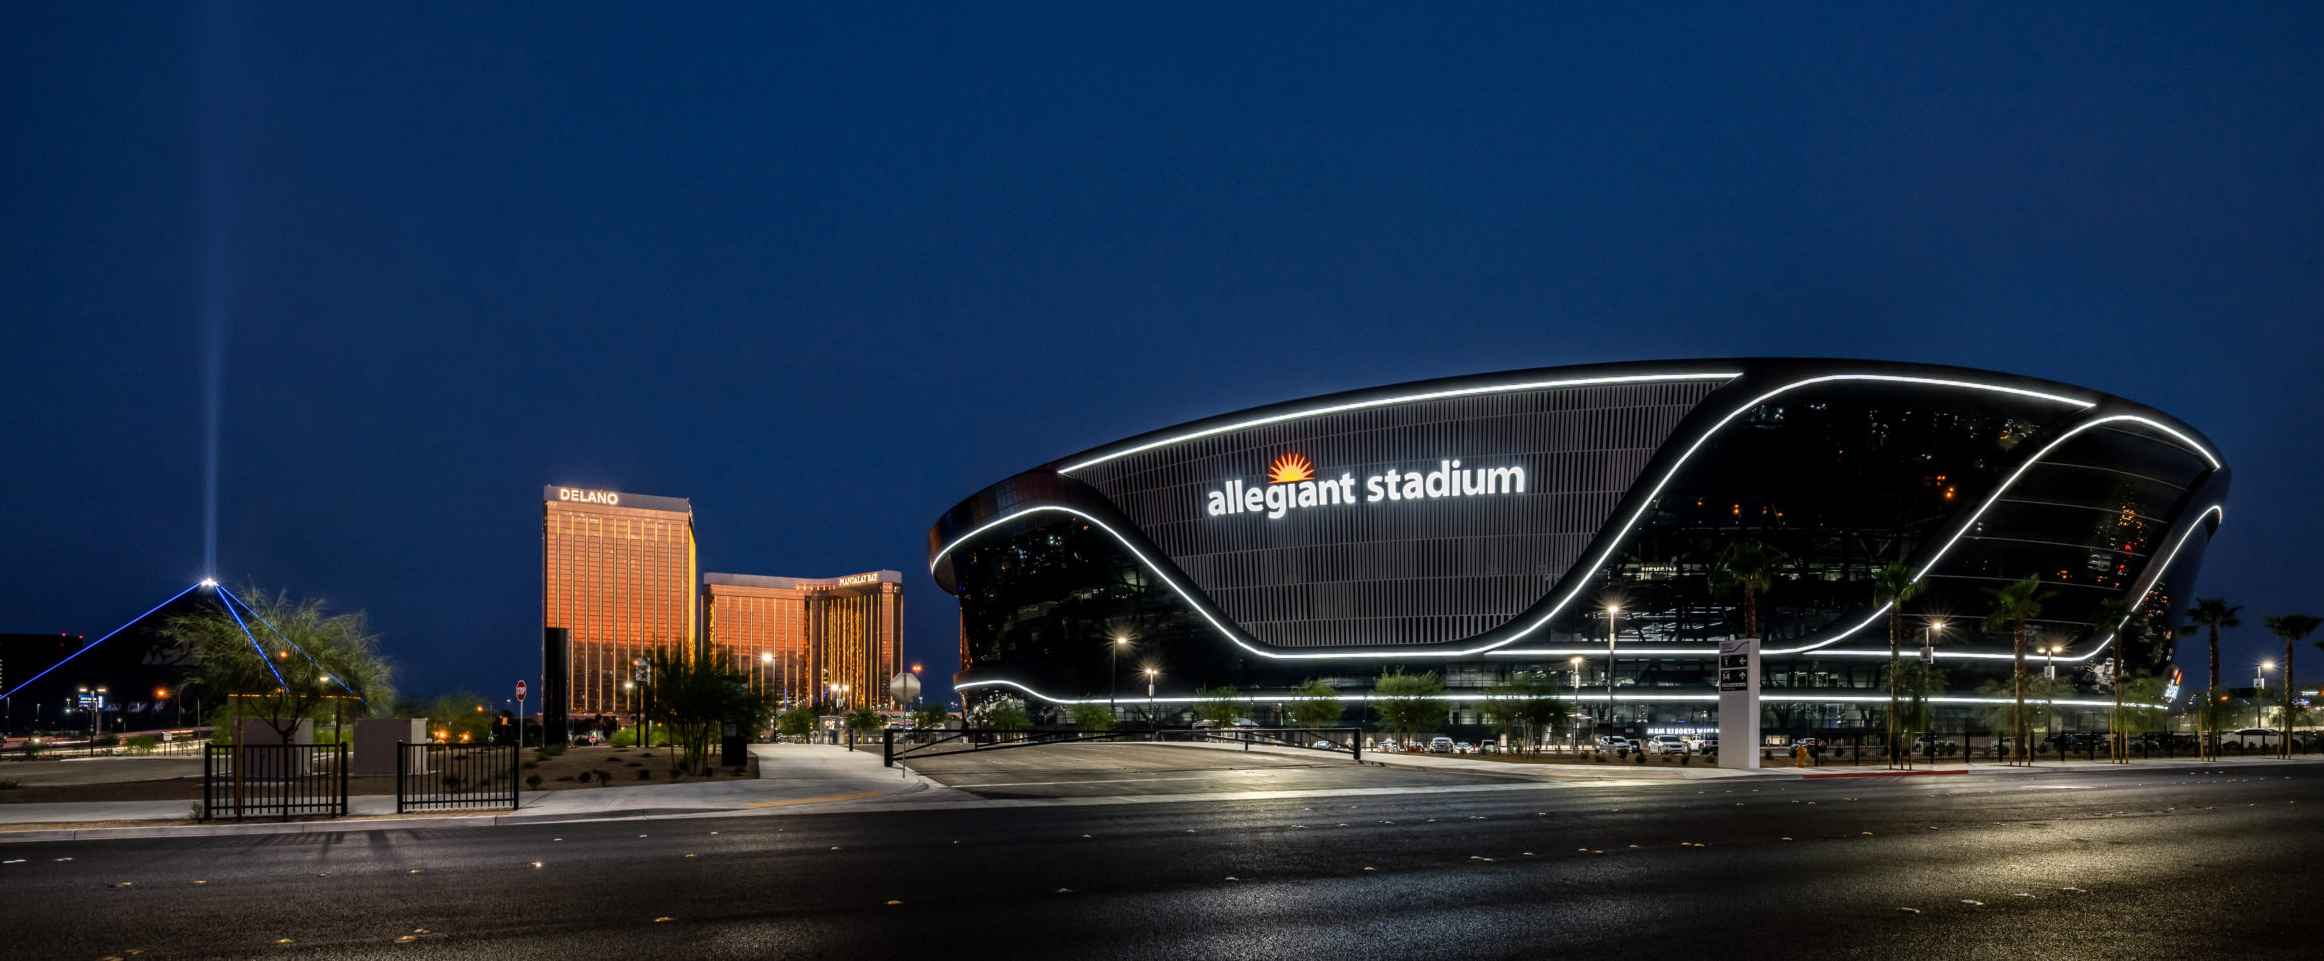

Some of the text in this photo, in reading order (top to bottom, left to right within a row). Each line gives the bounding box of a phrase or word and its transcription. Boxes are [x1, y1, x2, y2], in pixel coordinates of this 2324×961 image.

[560, 488, 618, 505] DELANO
[1208, 460, 1526, 520] allegiant stadium
[839, 573, 878, 586] MANDALAY BAY
[1722, 673, 1730, 681] 14
